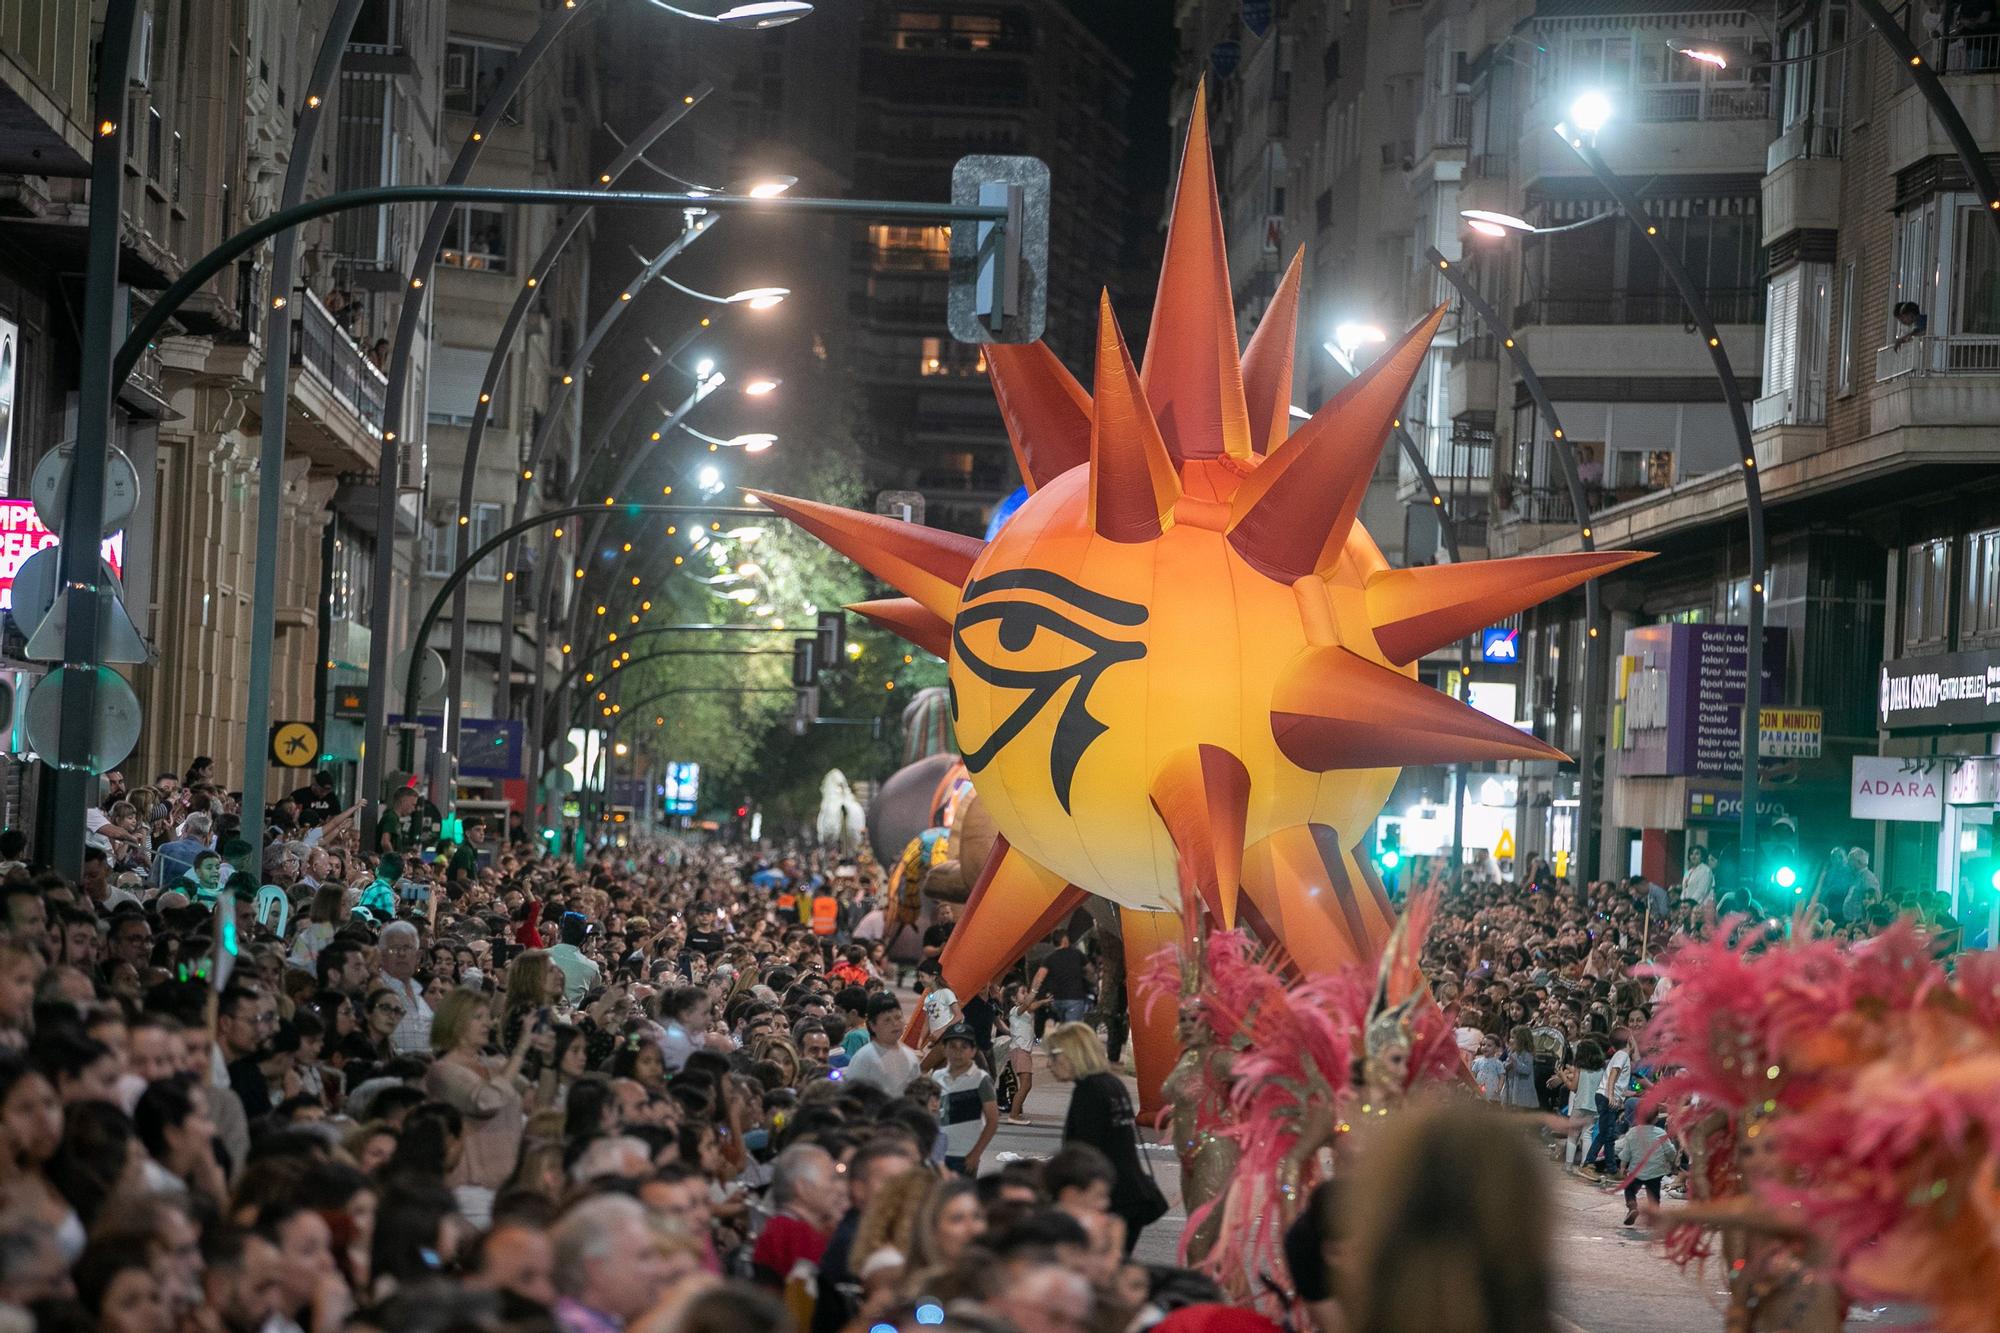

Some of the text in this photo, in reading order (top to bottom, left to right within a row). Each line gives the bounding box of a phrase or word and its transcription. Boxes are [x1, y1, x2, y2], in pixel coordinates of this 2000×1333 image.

[1734, 634, 1744, 642] de
[1782, 713, 1820, 730] MINUTO
[1698, 726, 1737, 736] Pareados
[1860, 780, 1936, 798] ADARA
